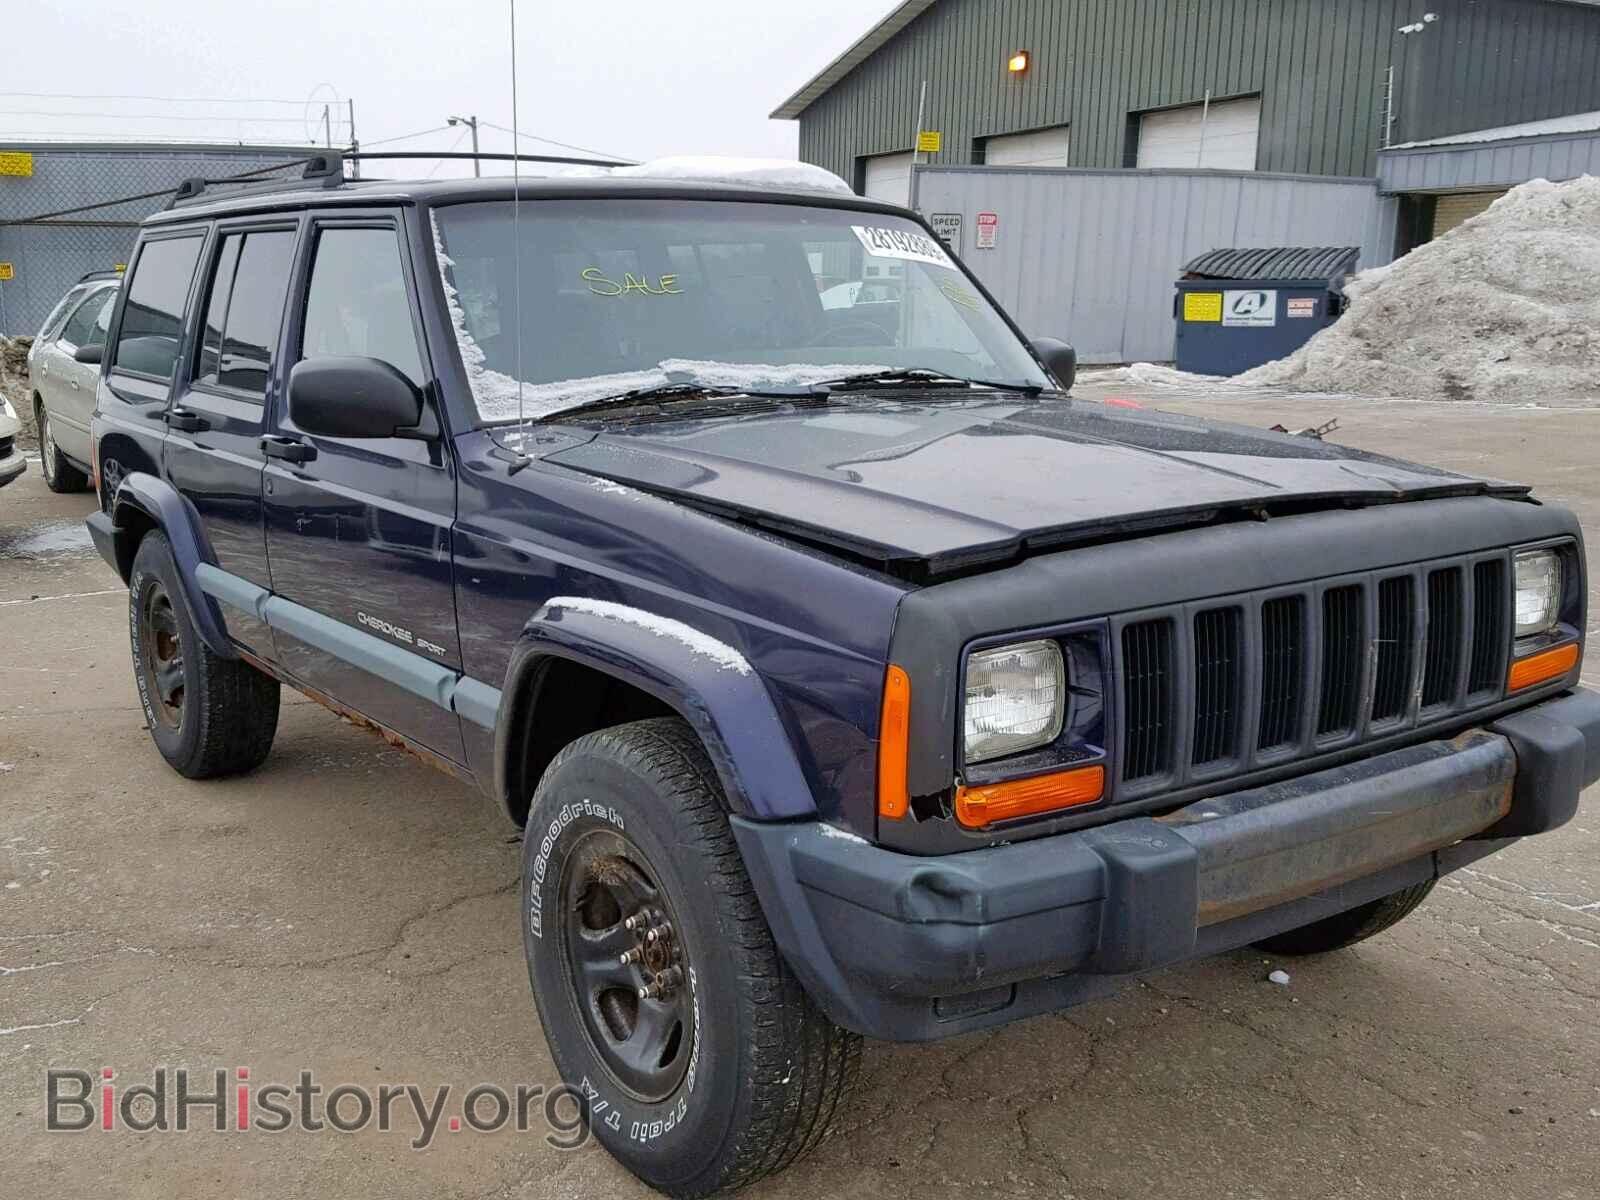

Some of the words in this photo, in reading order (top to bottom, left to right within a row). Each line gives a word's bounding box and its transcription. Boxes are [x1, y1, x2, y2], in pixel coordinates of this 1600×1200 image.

[933, 218, 961, 226] SPEED
[581, 266, 685, 296] SALE
[356, 611, 414, 644] CHEROKEE
[416, 637, 447, 657] SPORT
[530, 798, 625, 939] BFGoodrich
[630, 1095, 688, 1143] Trail
